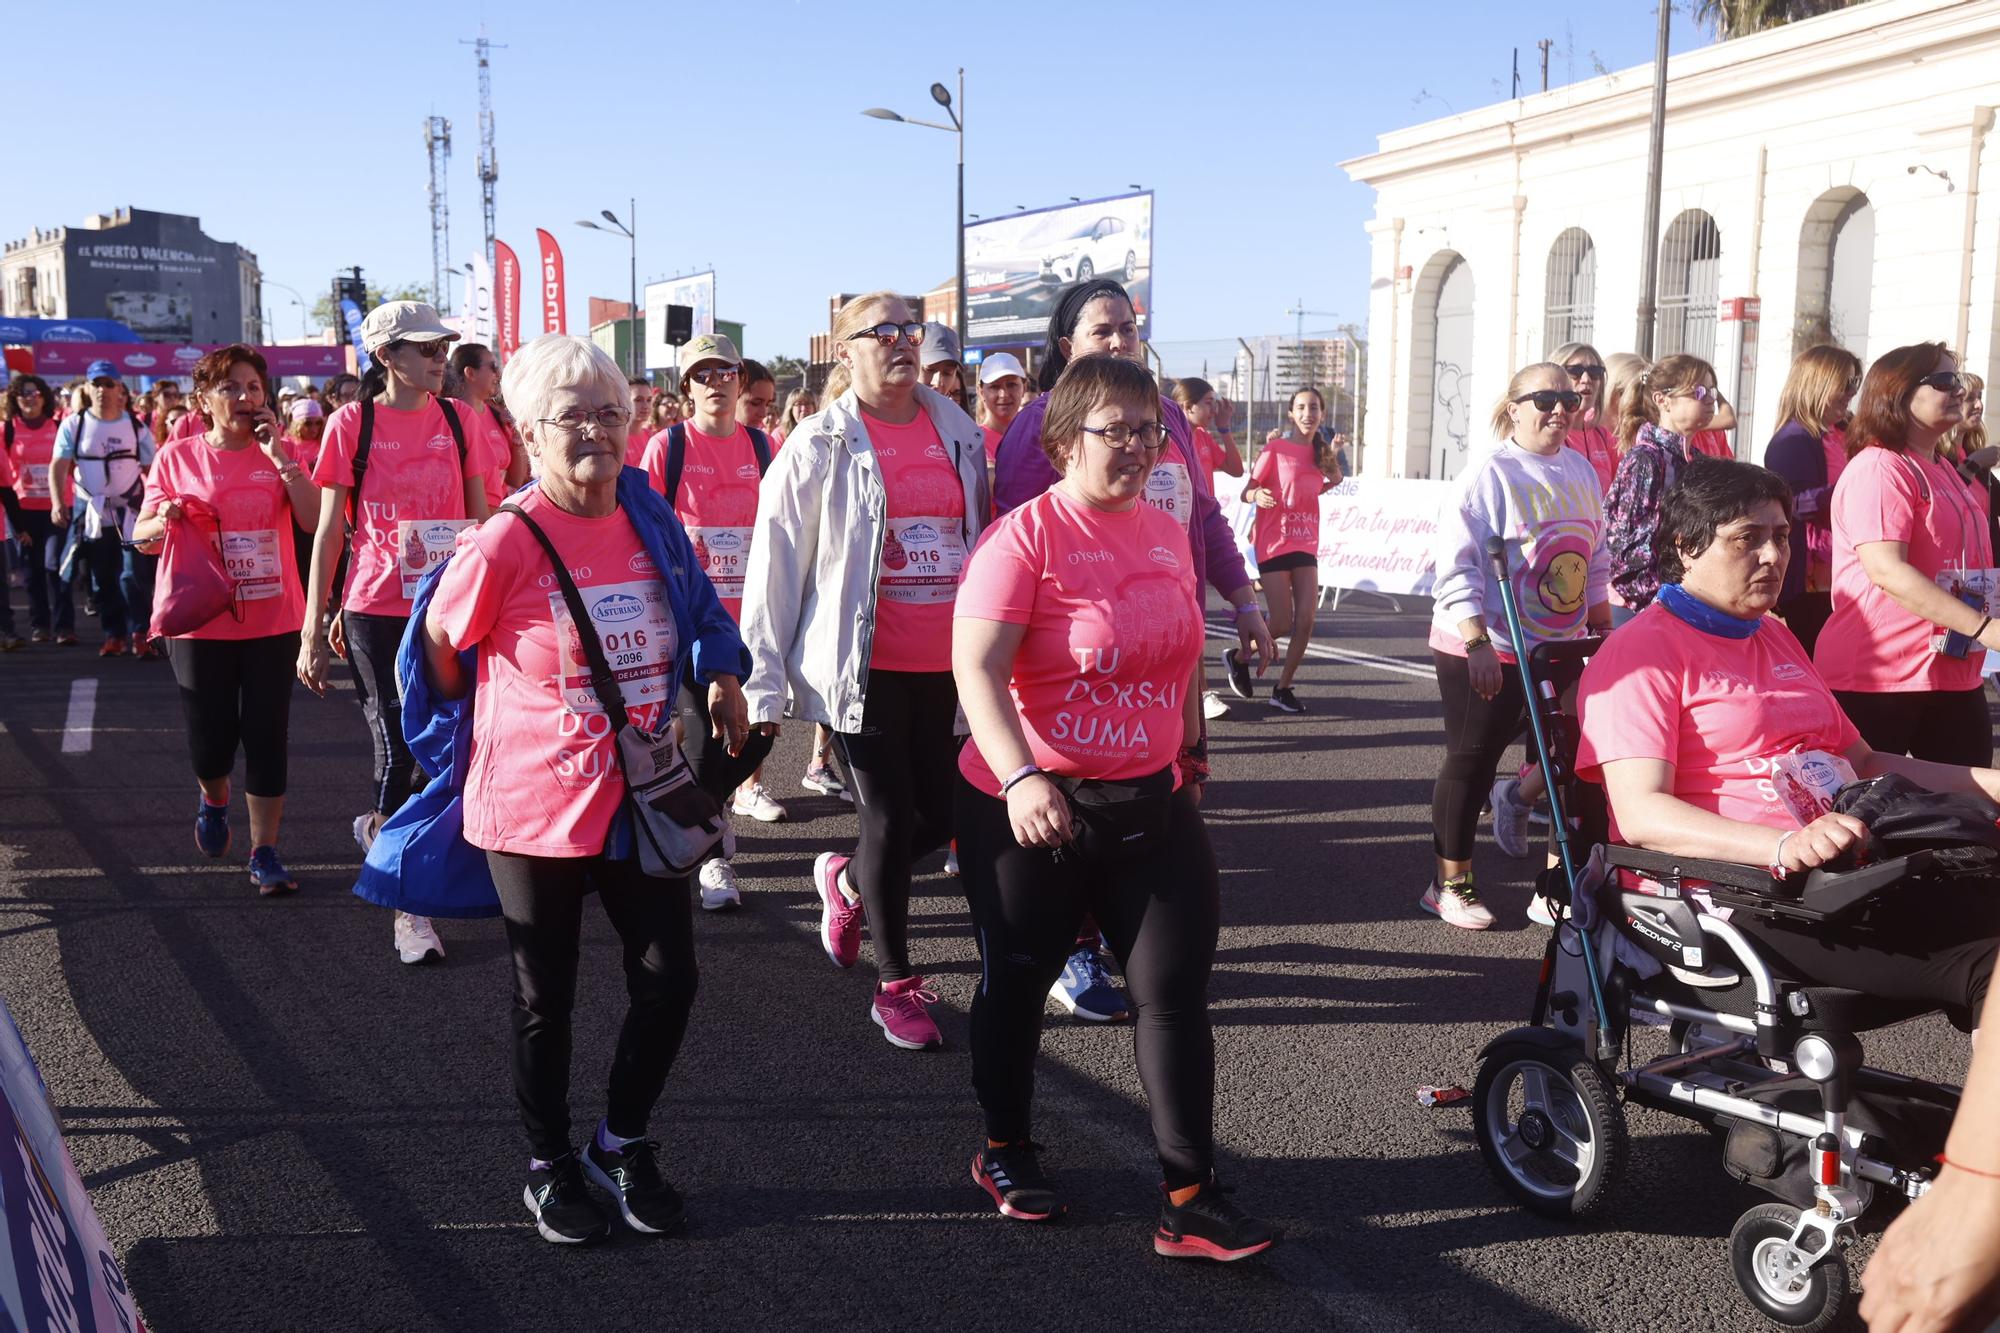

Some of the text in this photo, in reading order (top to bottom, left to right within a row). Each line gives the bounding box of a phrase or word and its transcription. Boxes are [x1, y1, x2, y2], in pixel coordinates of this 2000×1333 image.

[93, 245, 138, 259] PUERTO
[369, 503, 396, 521] TU
[713, 555, 738, 565] 016
[909, 550, 940, 562] 016
[227, 558, 255, 569] 016
[917, 565, 937, 573] 1178
[538, 566, 592, 588] OYHO
[717, 567, 734, 575] 4736
[597, 605, 642, 618] ASTURIANA
[605, 629, 647, 651] 016
[616, 651, 643, 666] 2096
[1074, 647, 1119, 674] TU
[618, 672, 628, 680] DE
[1050, 711, 1150, 748] SUMA
[1631, 919, 1683, 952] Discover 2
